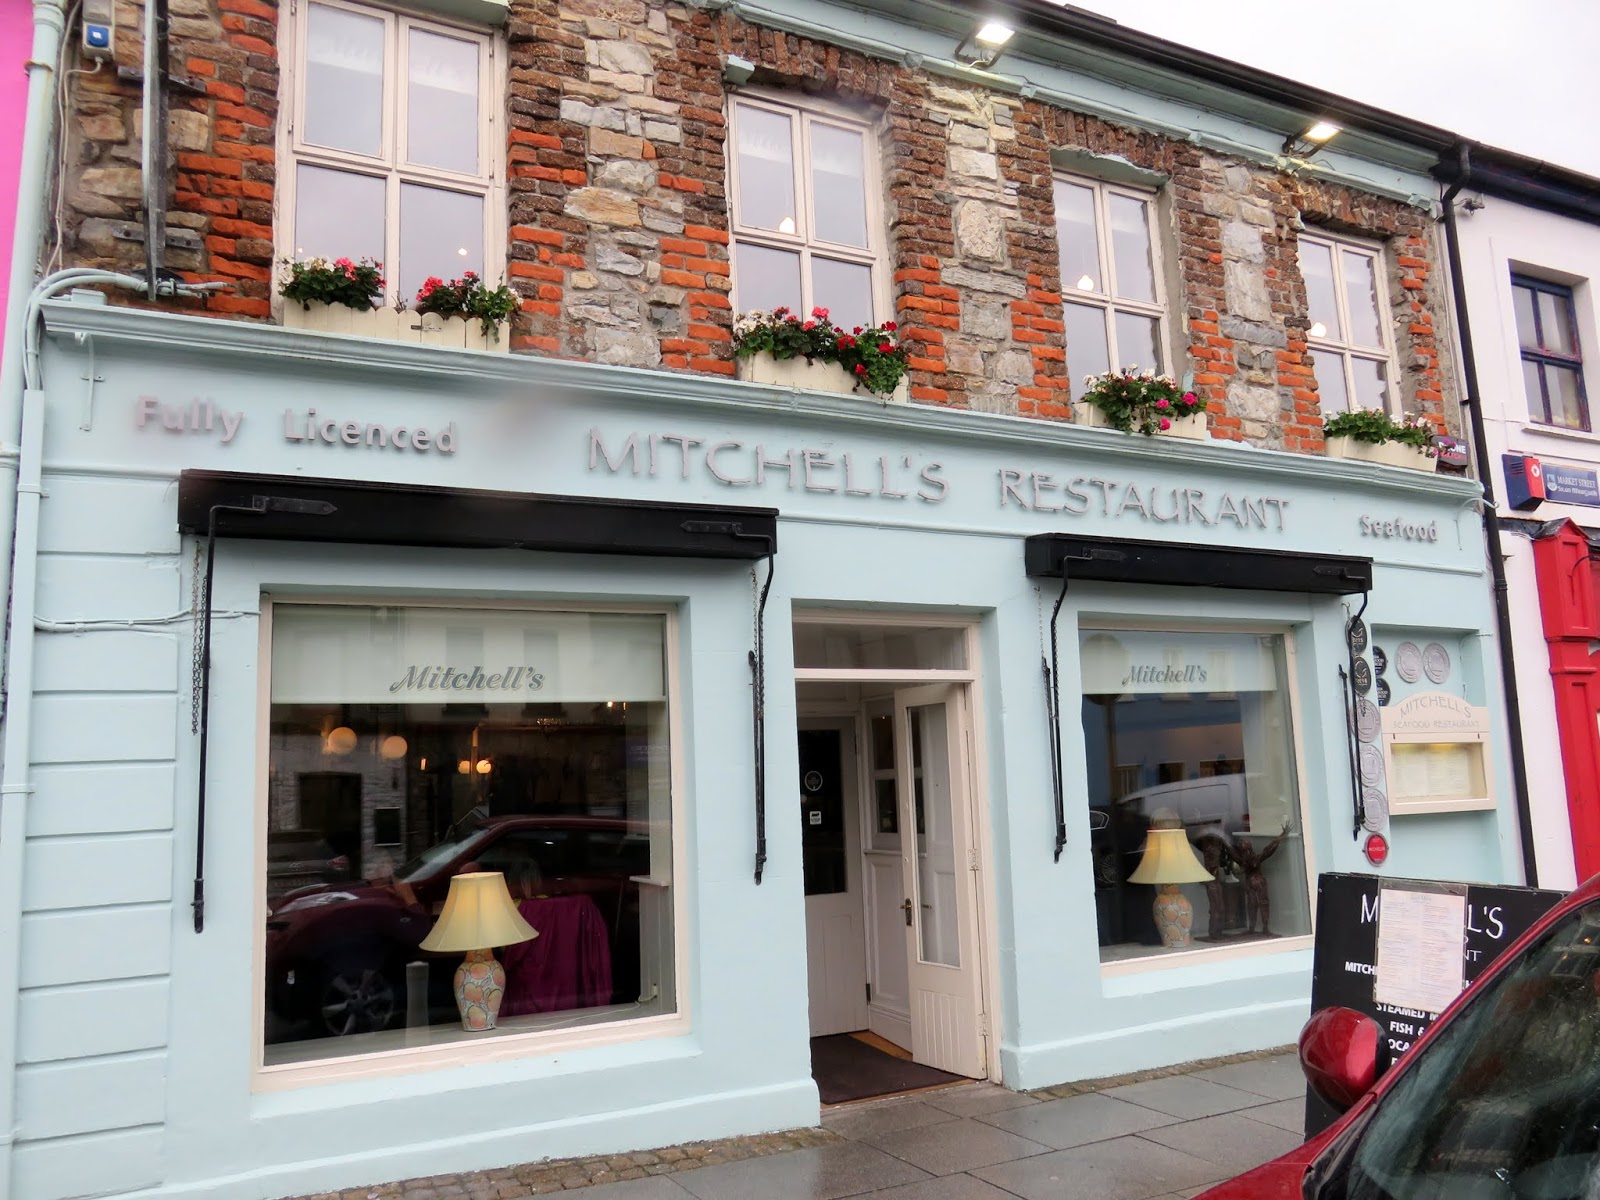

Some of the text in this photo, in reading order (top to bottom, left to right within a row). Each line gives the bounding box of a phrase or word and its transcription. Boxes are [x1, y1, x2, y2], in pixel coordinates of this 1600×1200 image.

[136, 395, 458, 455] Fully Licenced
[587, 425, 1290, 531] MITCHELL'S RESTAURANT
[1557, 475, 1596, 489] MARKET STREET
[1360, 513, 1438, 542] Seafood
[389, 665, 544, 692] Mitchell's
[1121, 664, 1208, 686] Mitchell's
[1393, 721, 1480, 729] SEAFOOD RESTAURANT
[1390, 1021, 1413, 1035] FISH
